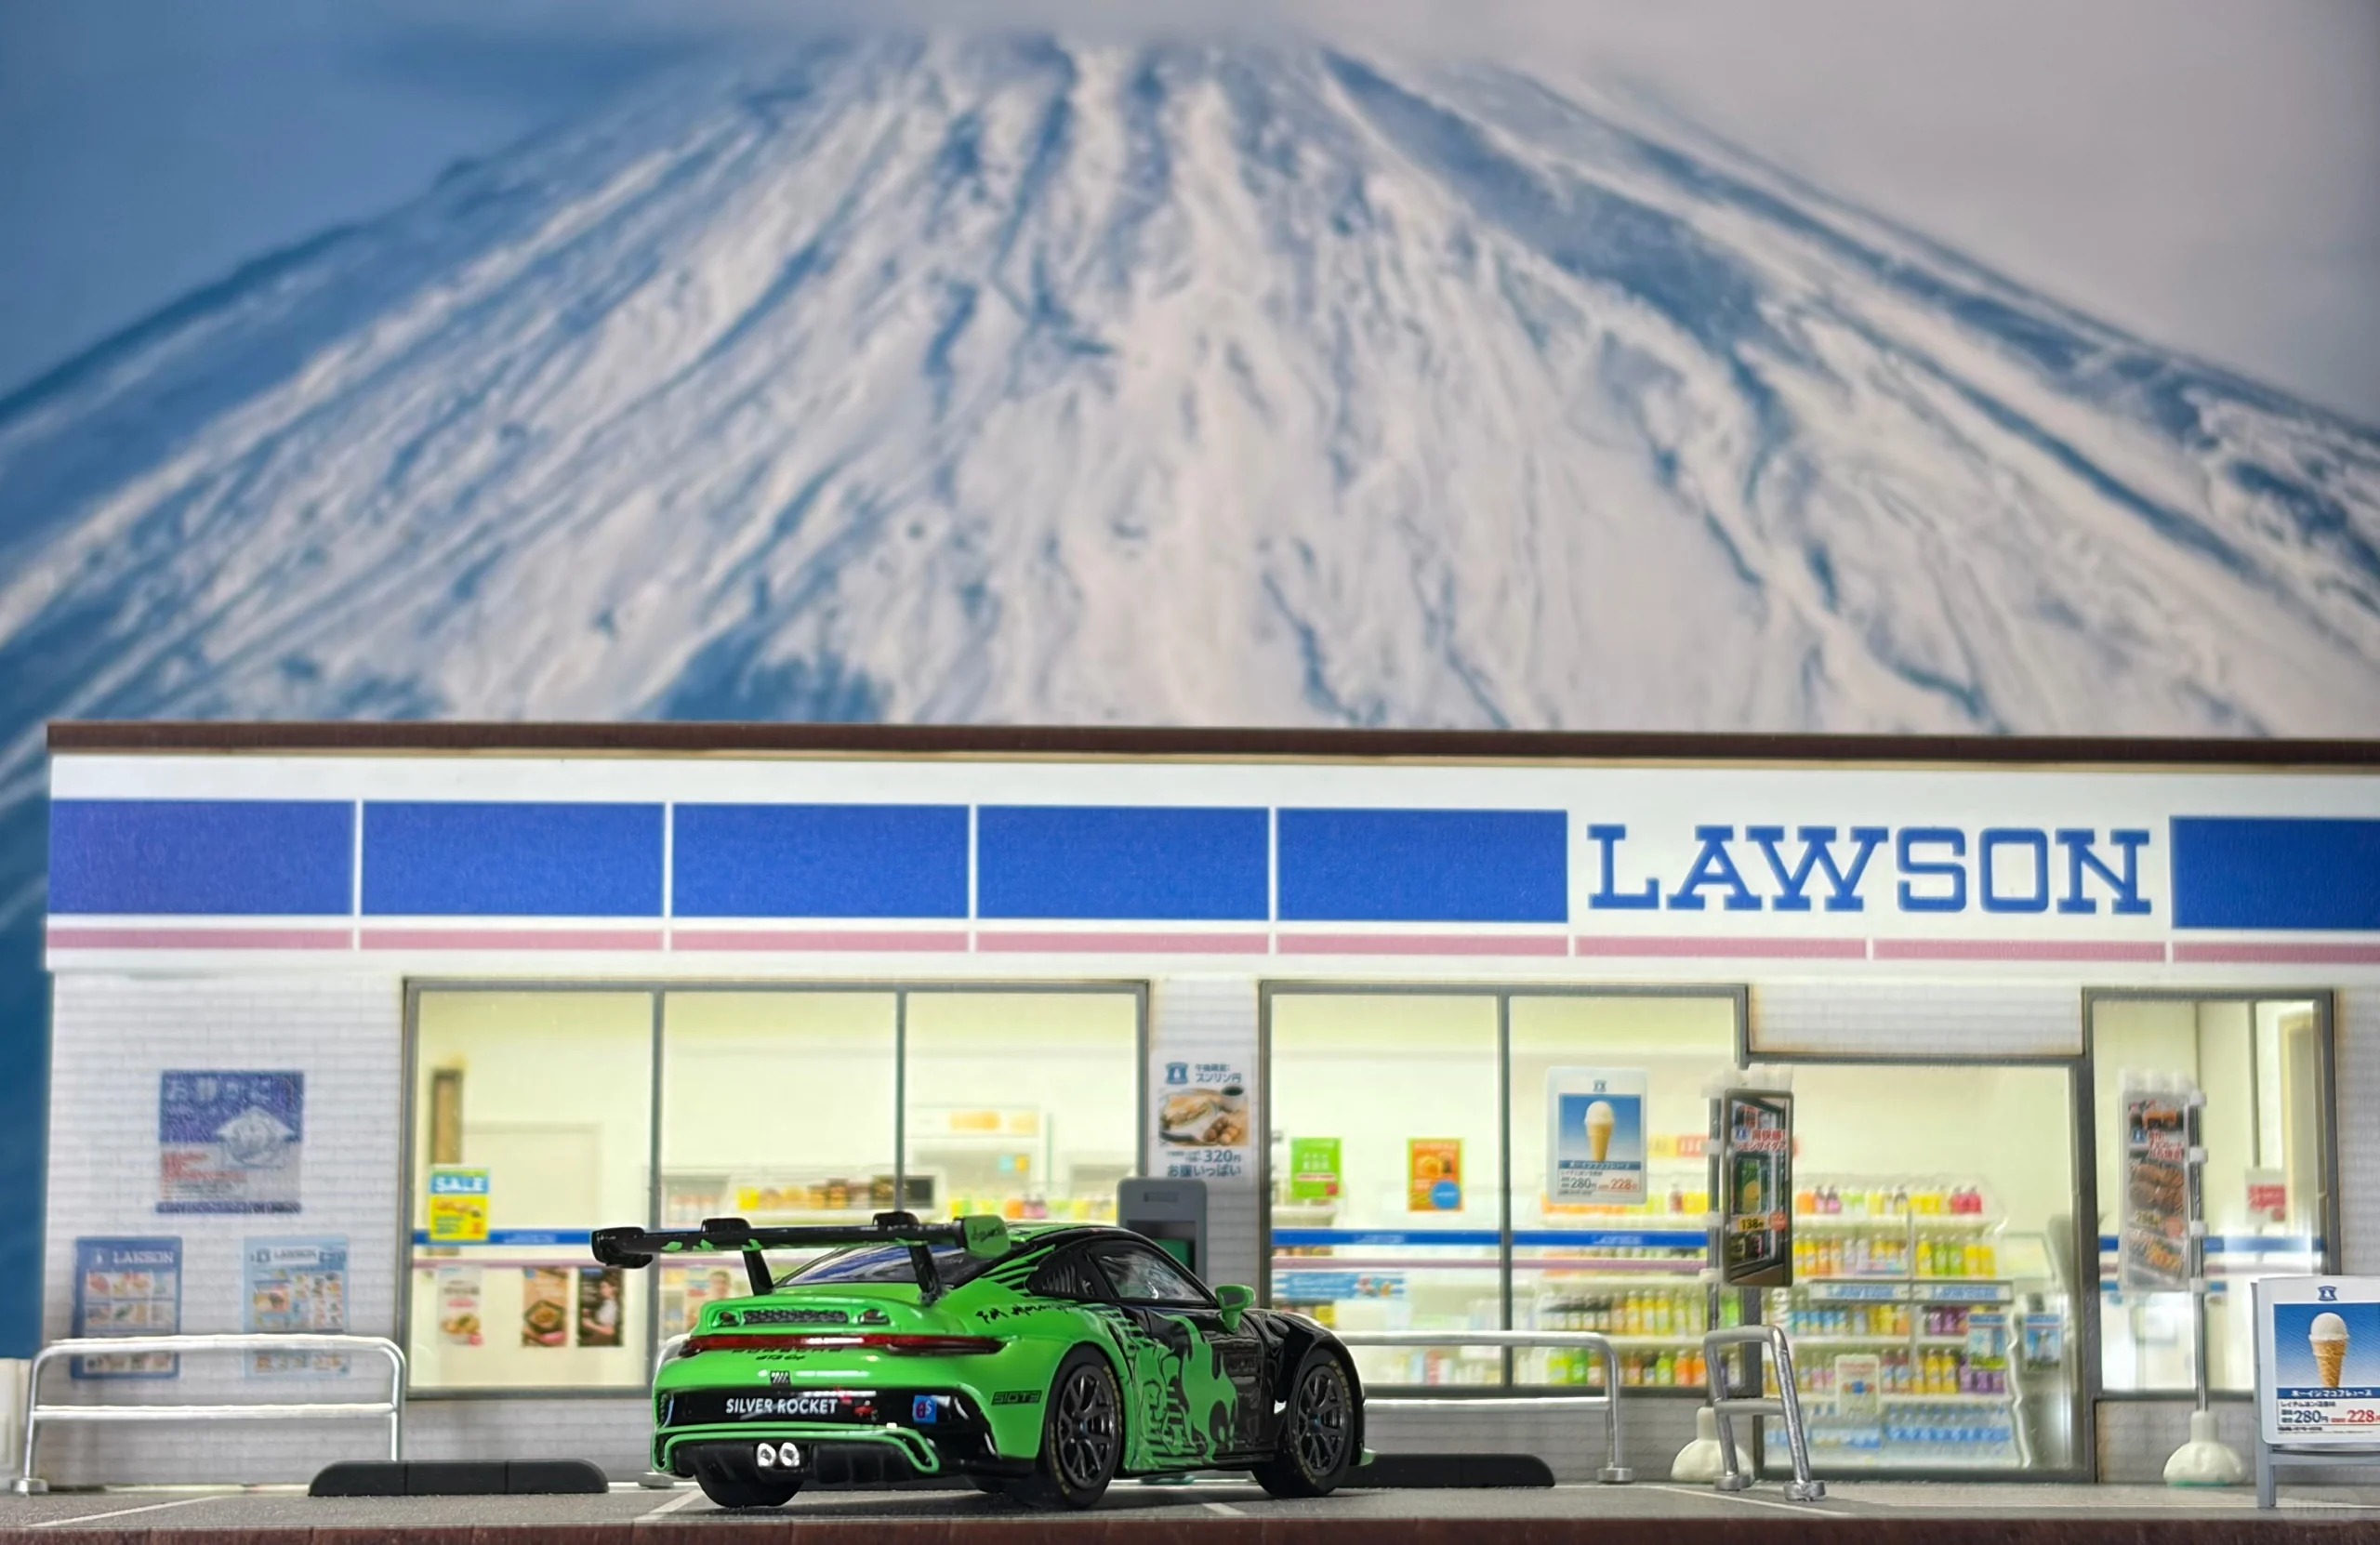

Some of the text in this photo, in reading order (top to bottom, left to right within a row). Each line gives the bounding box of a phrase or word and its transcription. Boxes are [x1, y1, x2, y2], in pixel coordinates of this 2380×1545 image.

[1587, 824, 2151, 915] LAWSON
[435, 1177, 484, 1193] SALE
[725, 1398, 839, 1415] SILVER ROCKET
